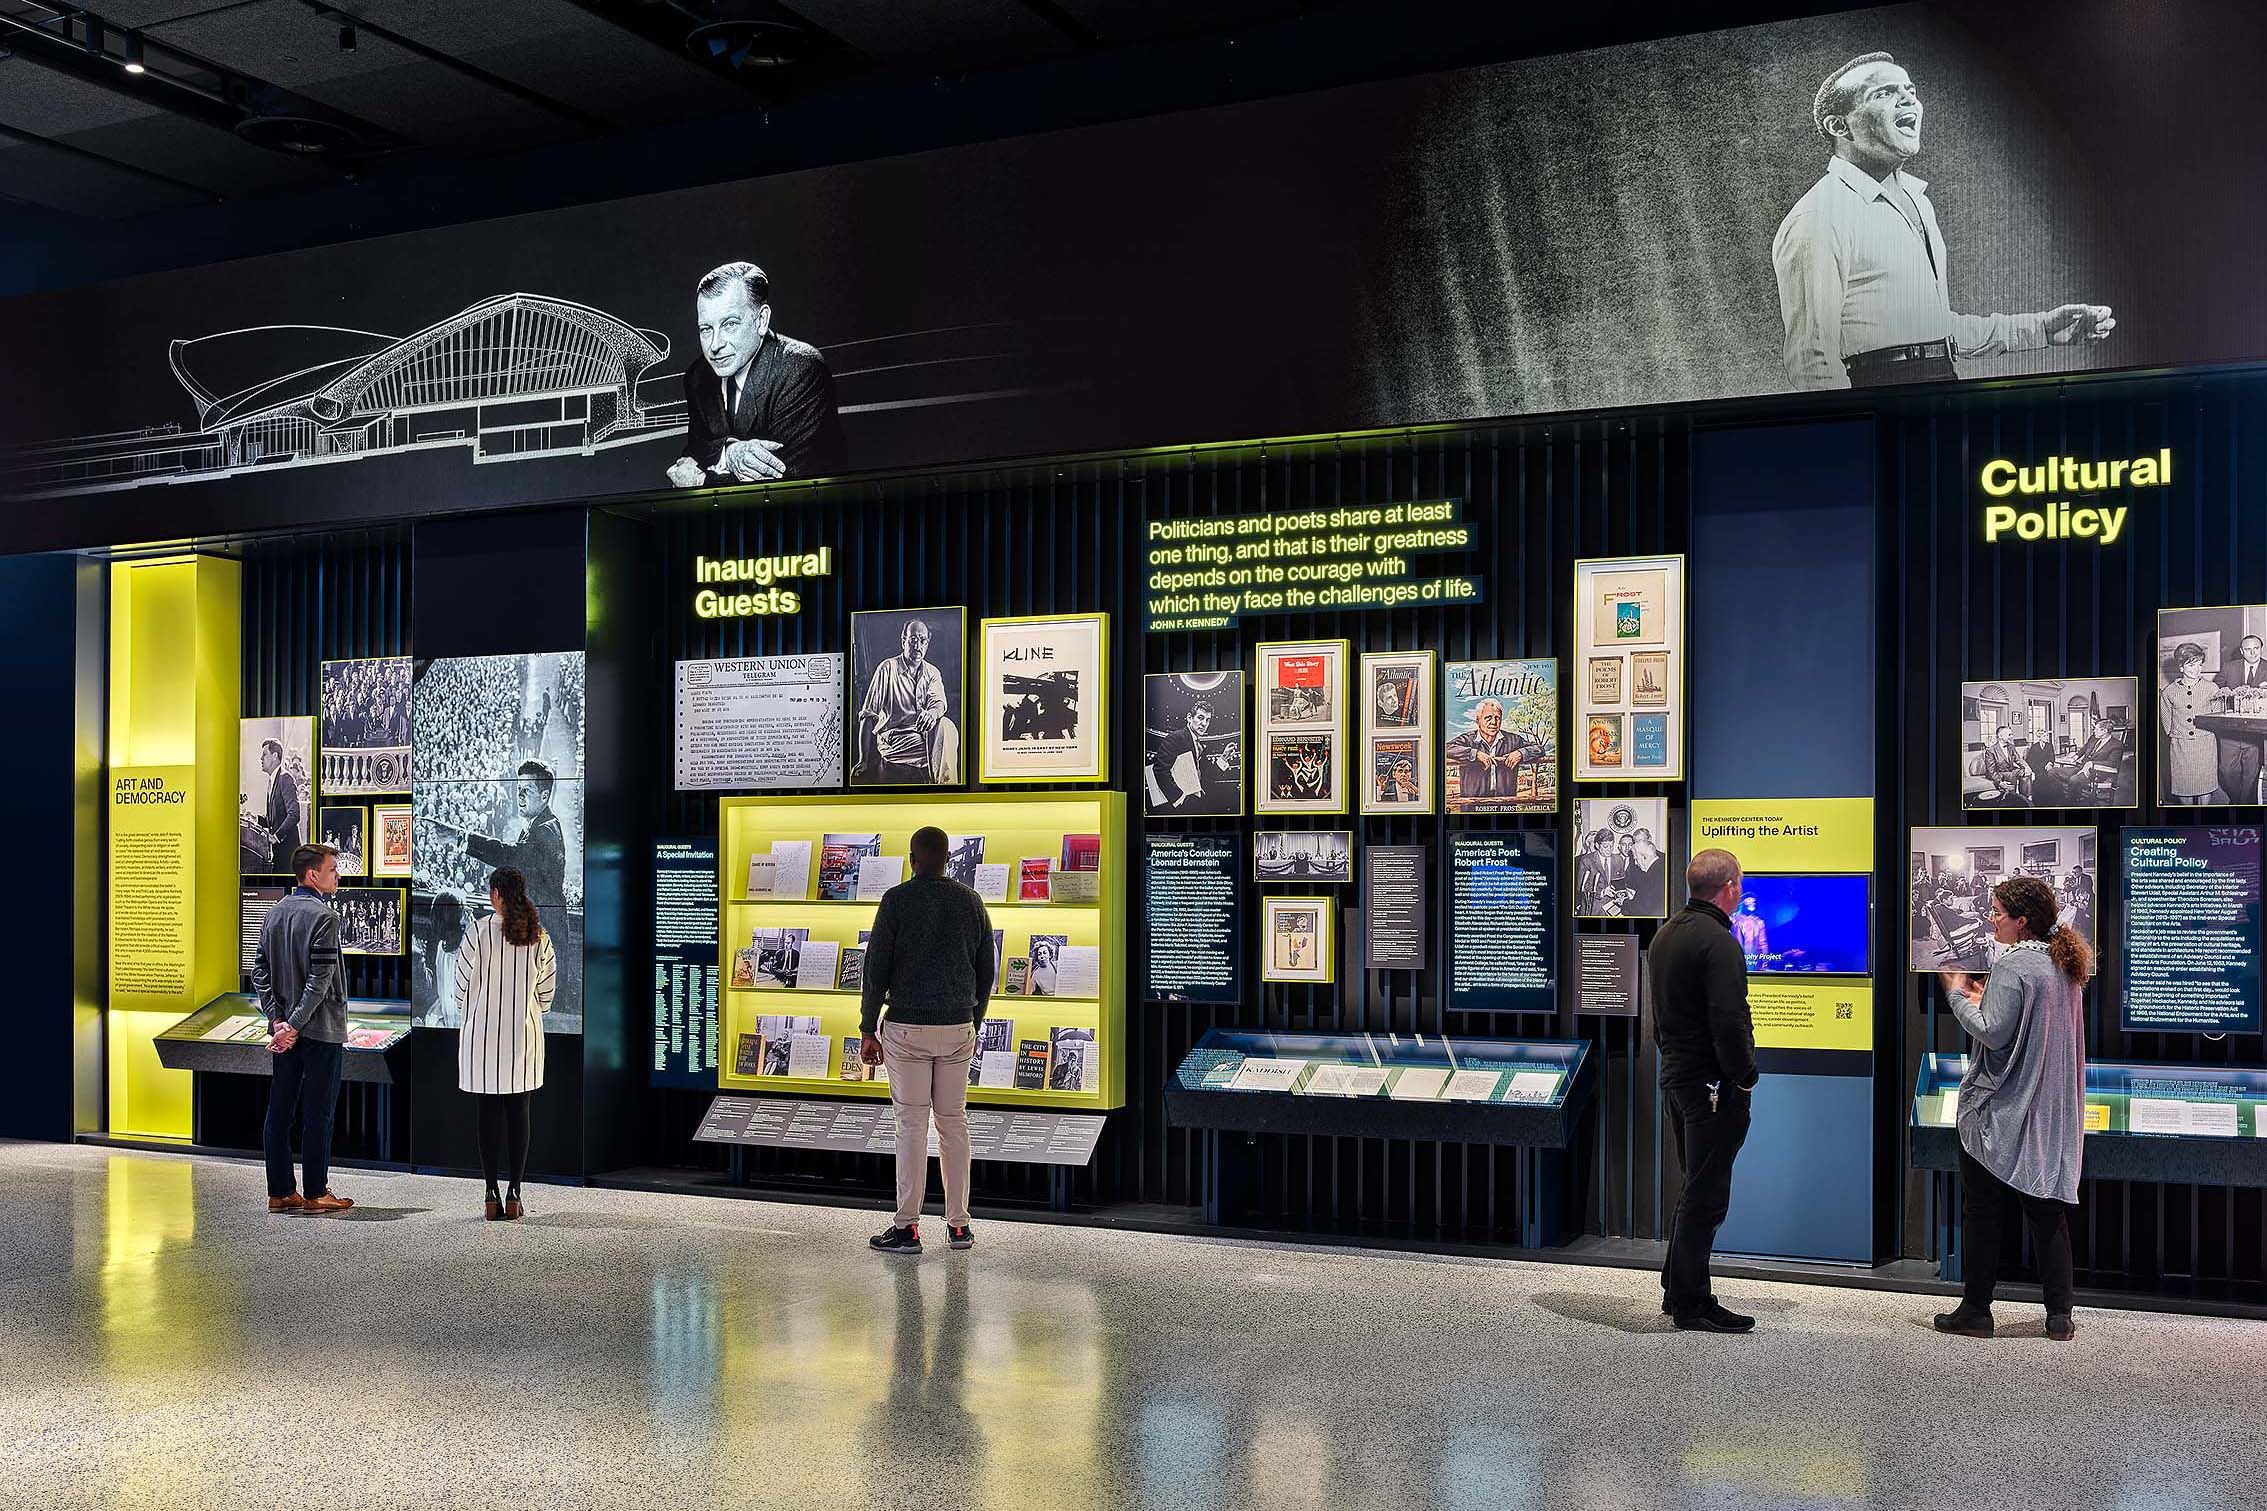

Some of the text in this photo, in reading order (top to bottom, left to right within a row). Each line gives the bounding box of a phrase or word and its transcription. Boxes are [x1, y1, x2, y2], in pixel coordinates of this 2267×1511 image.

[1982, 448, 2170, 496] Cultural
[1150, 502, 1452, 541] Politicians and poets share at least
[1986, 502, 2127, 544] Policy
[1150, 529, 1468, 565] one thing, and that is their greatness
[696, 547, 831, 586] Inaugural
[1150, 556, 1406, 592] depends on the courage with
[696, 587, 799, 618] Guests
[1150, 578, 1477, 614] which they face the challenges of life.
[1602, 591, 1643, 606] FROST
[1150, 617, 1229, 630] JOHN F. KENNEDY
[1003, 646, 1054, 662] KLINE
[714, 661, 765, 673] WESTERN
[769, 659, 806, 670] UNION
[1451, 666, 1546, 698] THE Atlantic
[1376, 742, 1412, 751] Newsweek
[116, 778, 164, 790] ART AND
[116, 791, 186, 804] DEMOCRACY
[1702, 825, 1819, 838] Uplifting the Artist
[663, 851, 686, 860] Special
[1190, 850, 1233, 858] Conductor:
[1455, 849, 1521, 857] America's Poet:
[2131, 847, 2177, 857] Creating
[1151, 858, 1220, 866] Leonard Bernstein
[1455, 858, 1508, 866] Robert Frost
[2131, 858, 2208, 868] Cultural Policy
[842, 1062, 862, 1072] EDEN
